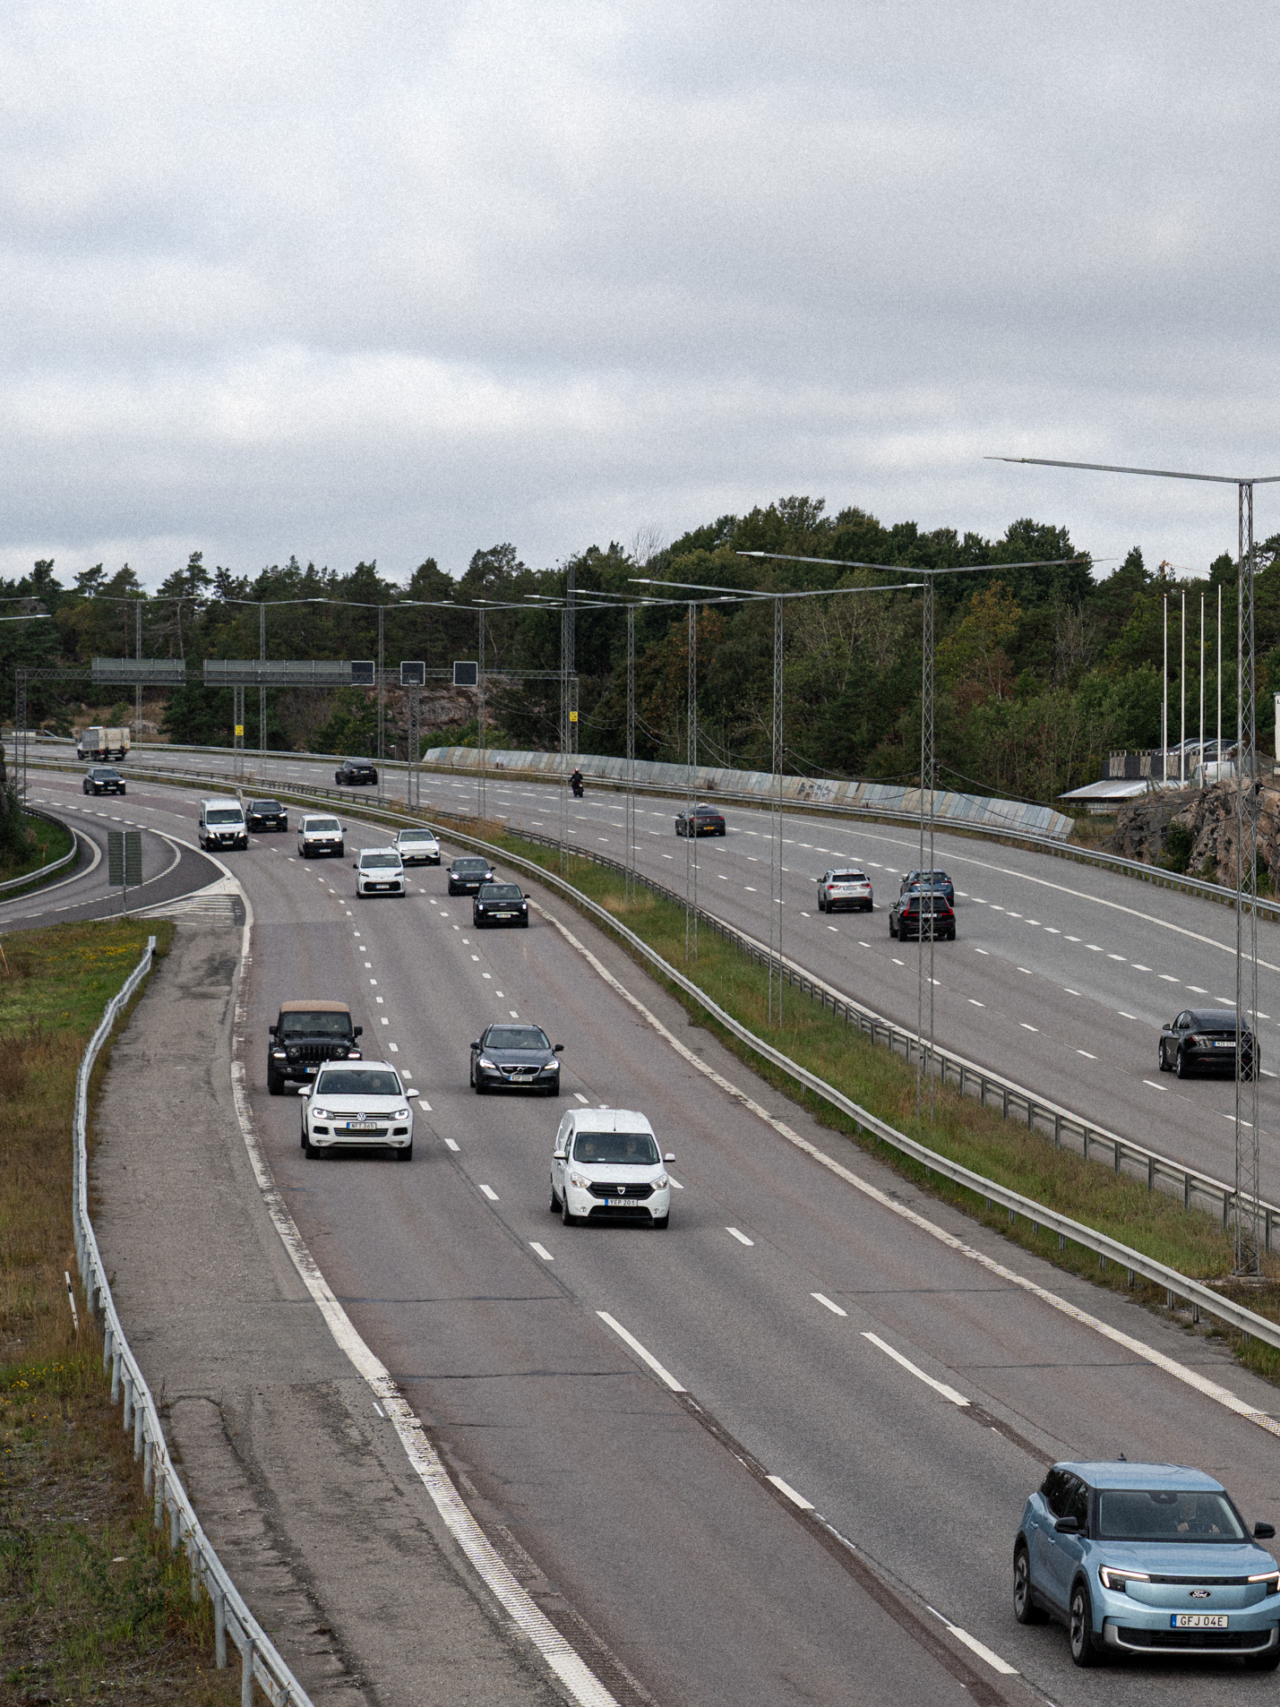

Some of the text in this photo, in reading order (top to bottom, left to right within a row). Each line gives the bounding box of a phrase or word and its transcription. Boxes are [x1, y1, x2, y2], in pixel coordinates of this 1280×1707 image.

[1192, 1590, 1208, 1598] Ford
[1180, 1616, 1223, 1627] GFJ 04E
